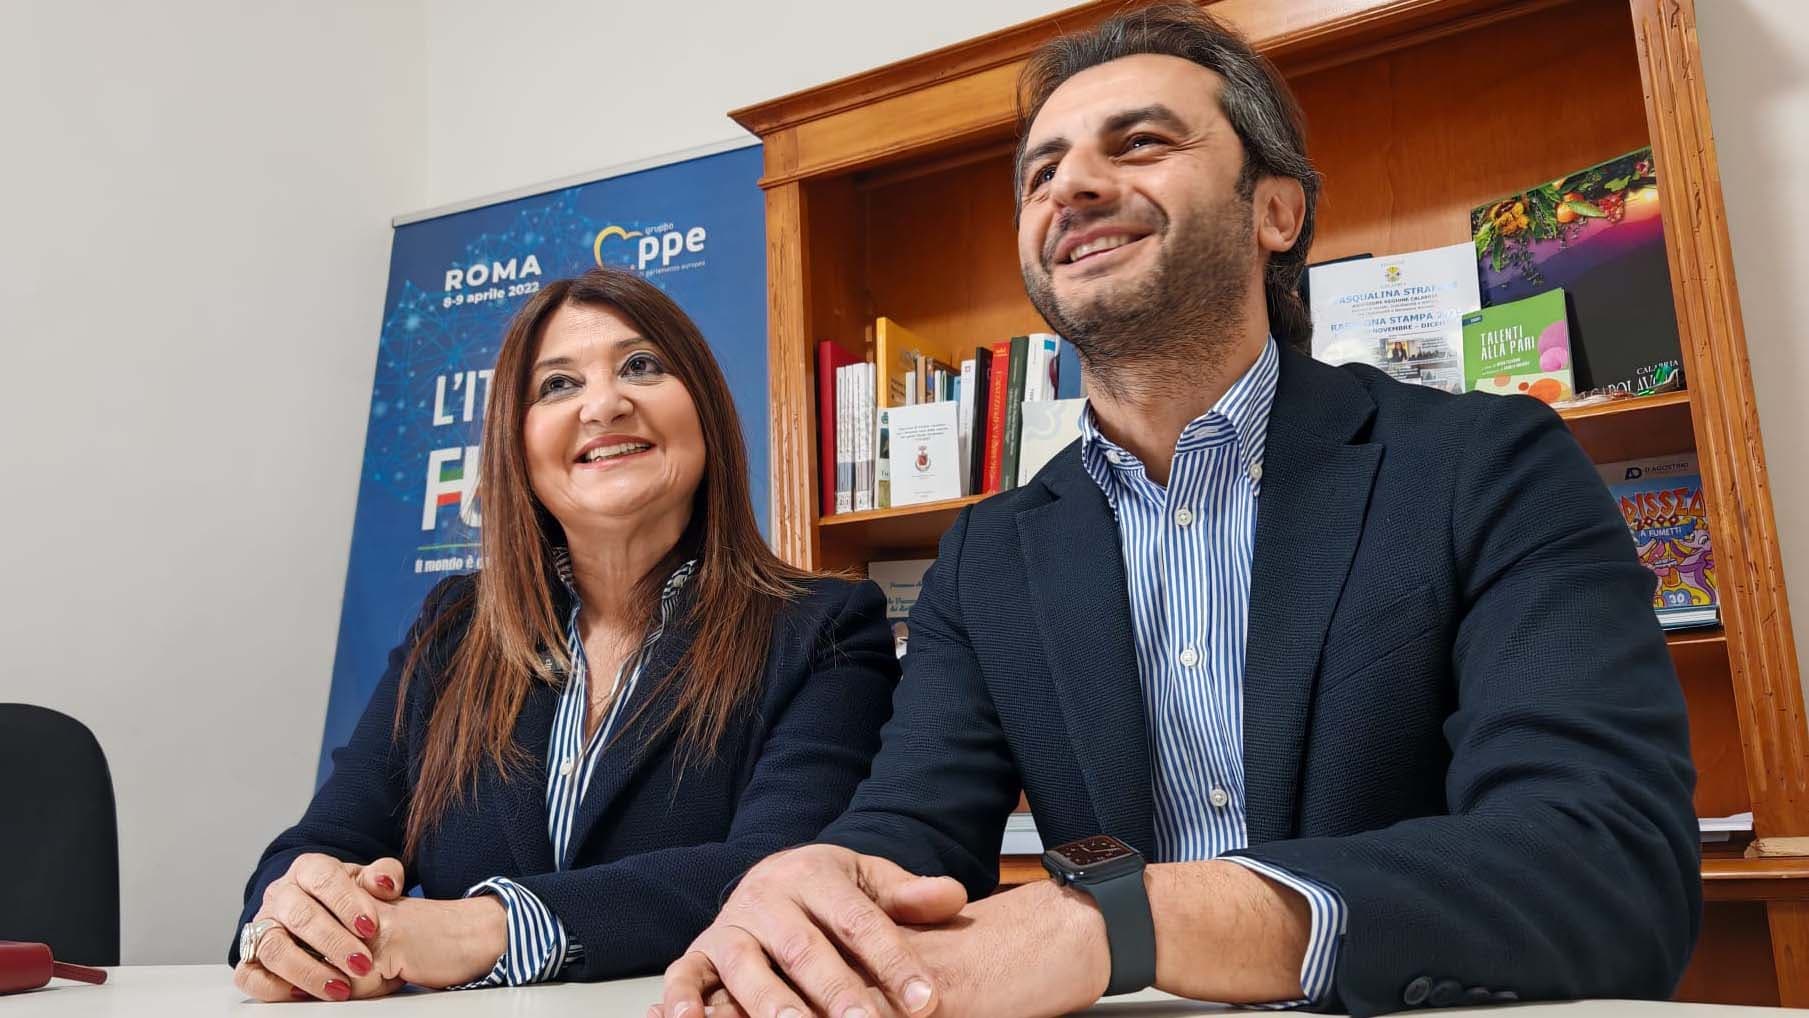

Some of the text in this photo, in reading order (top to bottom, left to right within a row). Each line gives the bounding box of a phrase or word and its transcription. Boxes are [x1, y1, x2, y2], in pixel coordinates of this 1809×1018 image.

[638, 227, 706, 270] ppe
[444, 254, 542, 292] ROMA
[443, 281, 540, 308] 8-9 aprile 2022
[1334, 289, 1401, 305] ASQUALINA
[1390, 312, 1433, 325] STAMPA
[1481, 325, 1522, 346] TALENTI
[1481, 336, 1535, 360] ALLA PARI
[1649, 527, 1682, 537] FUMETTI
[425, 557, 463, 572] mondo
[1669, 592, 1685, 604] 30
